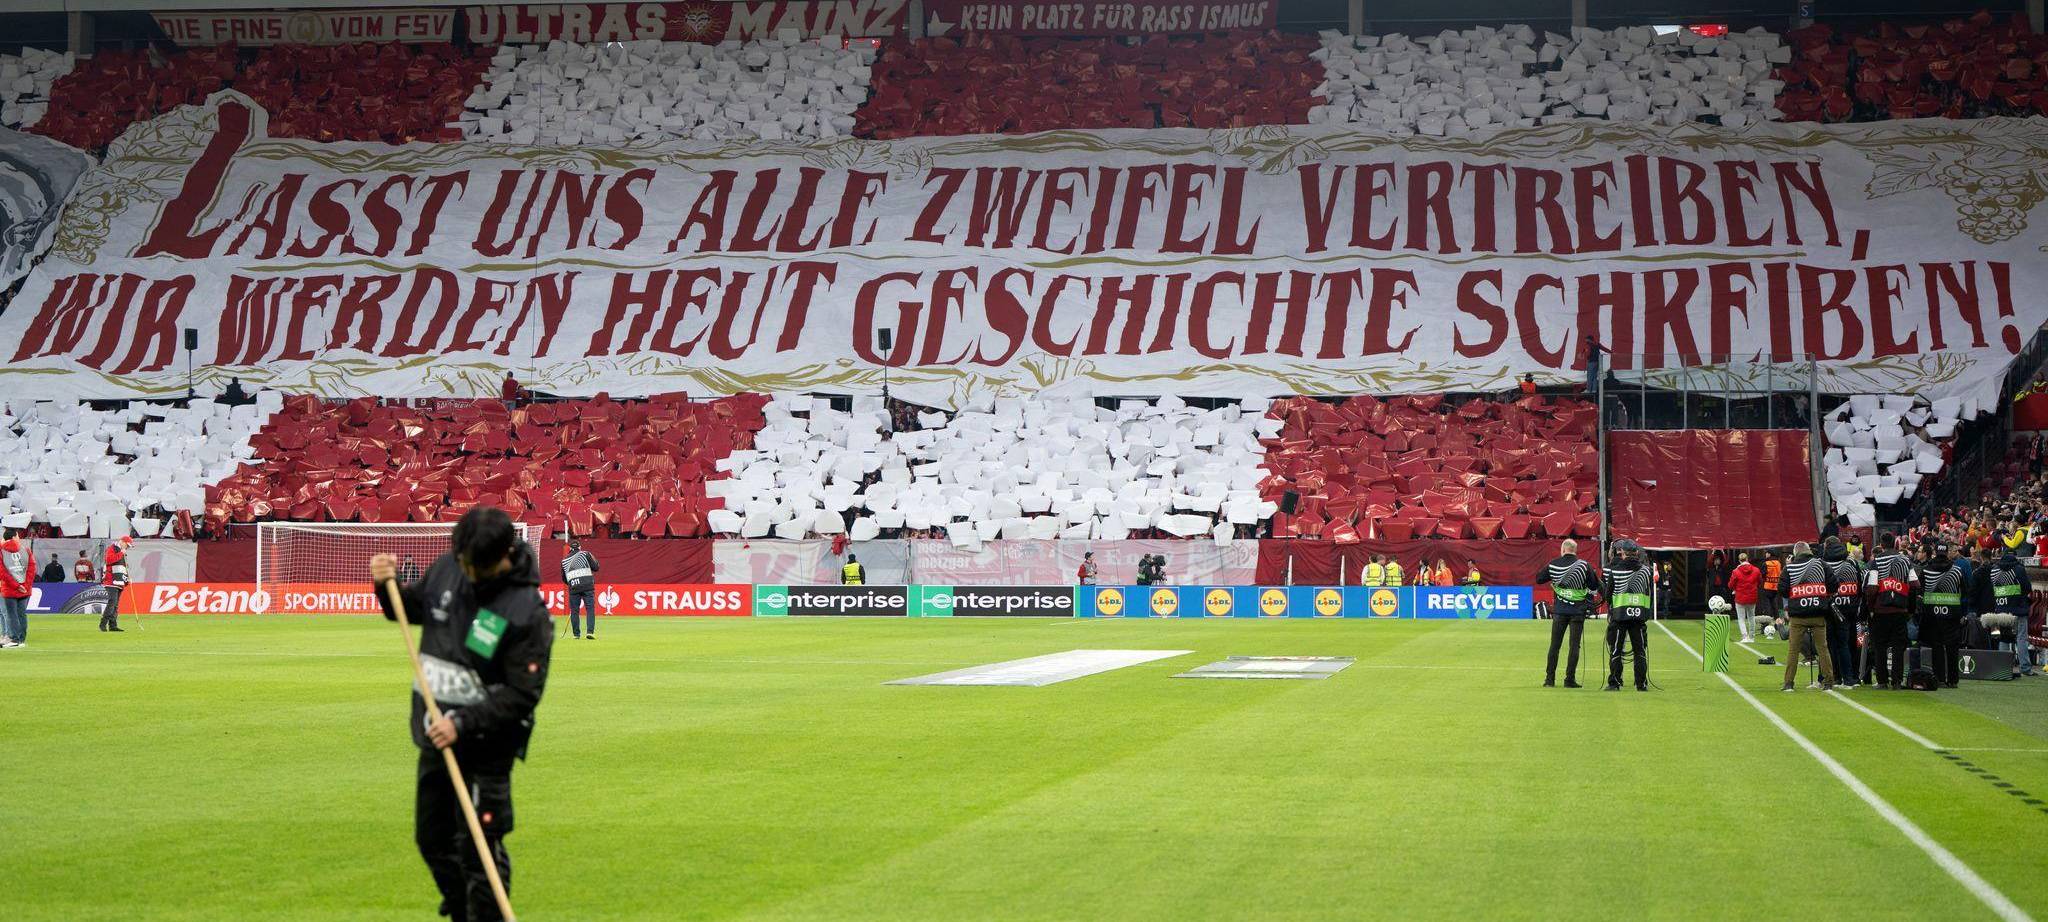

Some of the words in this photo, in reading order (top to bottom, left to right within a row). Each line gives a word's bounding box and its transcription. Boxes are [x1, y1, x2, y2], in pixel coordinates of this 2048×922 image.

[163, 18, 201, 39] DIE
[212, 18, 283, 40] FANS
[331, 16, 383, 38] VOM
[395, 15, 449, 37] FSV
[465, 4, 667, 42] ULTRAS
[726, 1, 904, 40] MAINZ
[960, 5, 1012, 31] KEIN
[1022, 4, 1085, 30] PLATZ
[1093, 3, 1135, 30] FÜR
[134, 101, 470, 259] LASST
[472, 169, 656, 258] UNS
[664, 168, 888, 253] ALLE
[905, 164, 1262, 255] ZWEIFEL
[1298, 154, 1871, 261] VERTREIBEN,
[9, 273, 196, 375] WIR
[201, 267, 582, 367] WERDEN
[584, 261, 838, 360] HEUT
[852, 266, 1422, 368] GESCHICHTE
[1453, 261, 2021, 371] SCHREIBEN!
[150, 585, 271, 613] Betano
[633, 591, 742, 610] STRAUSS
[1791, 585, 1827, 596] PHOTO
[766, 591, 905, 612] enterprise
[931, 591, 1073, 612] enterprise
[1428, 594, 1519, 610] RECYCLE
[1800, 597, 1820, 607] 075
[1934, 606, 1949, 615] 010
